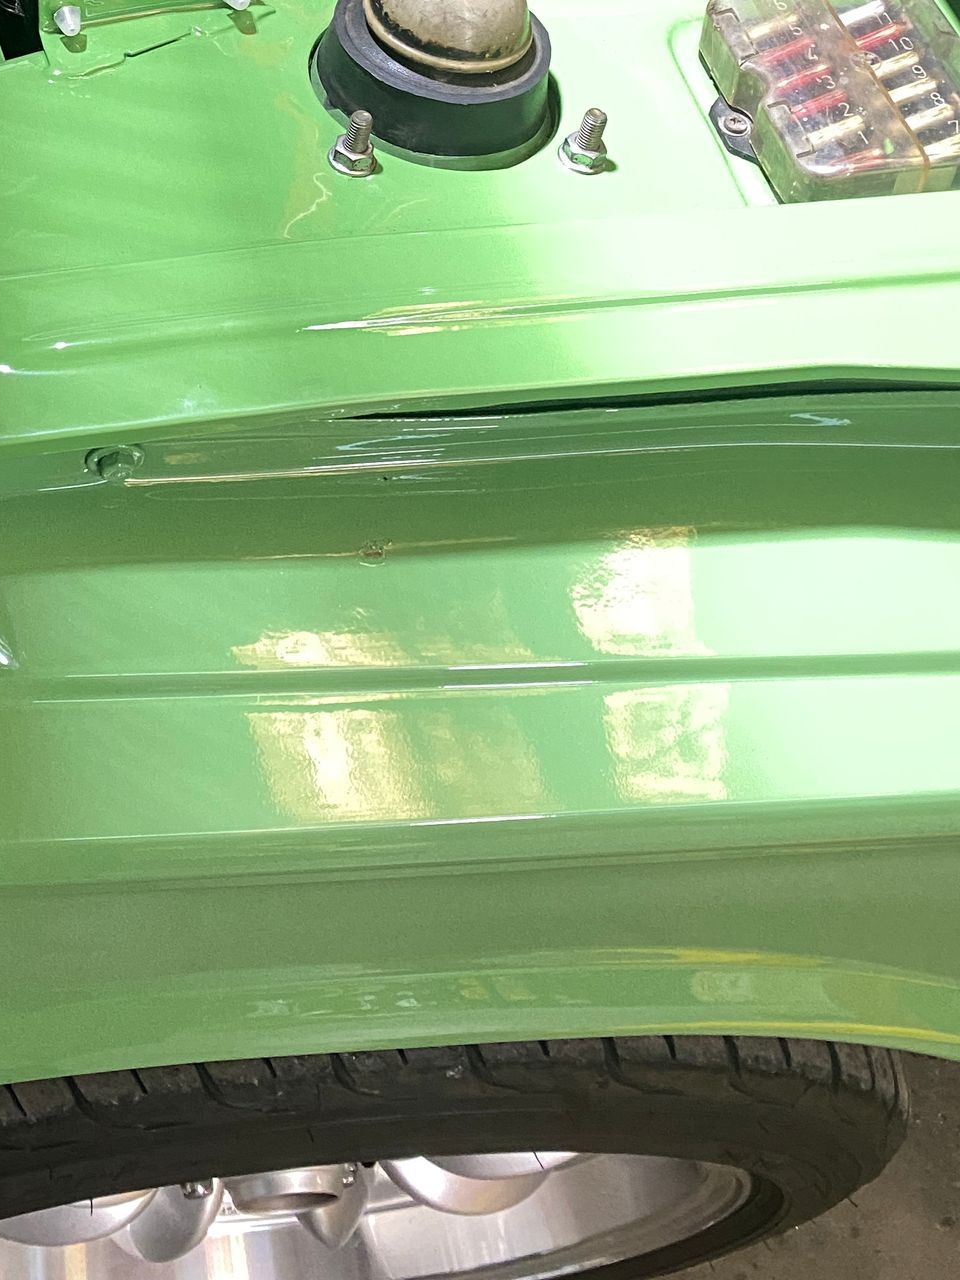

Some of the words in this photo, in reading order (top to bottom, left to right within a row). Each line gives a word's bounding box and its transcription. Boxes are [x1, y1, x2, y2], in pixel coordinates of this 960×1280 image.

[875, 12, 893, 24] 11
[790, 24, 804, 36] 5
[888, 36, 914, 52] 10
[807, 47, 819, 61] 4
[912, 65, 927, 80] 9
[823, 75, 836, 90] 3
[930, 92, 945, 107] 8
[839, 103, 854, 117] 2
[947, 120, 960, 133] 7
[858, 131, 869, 145] 1
